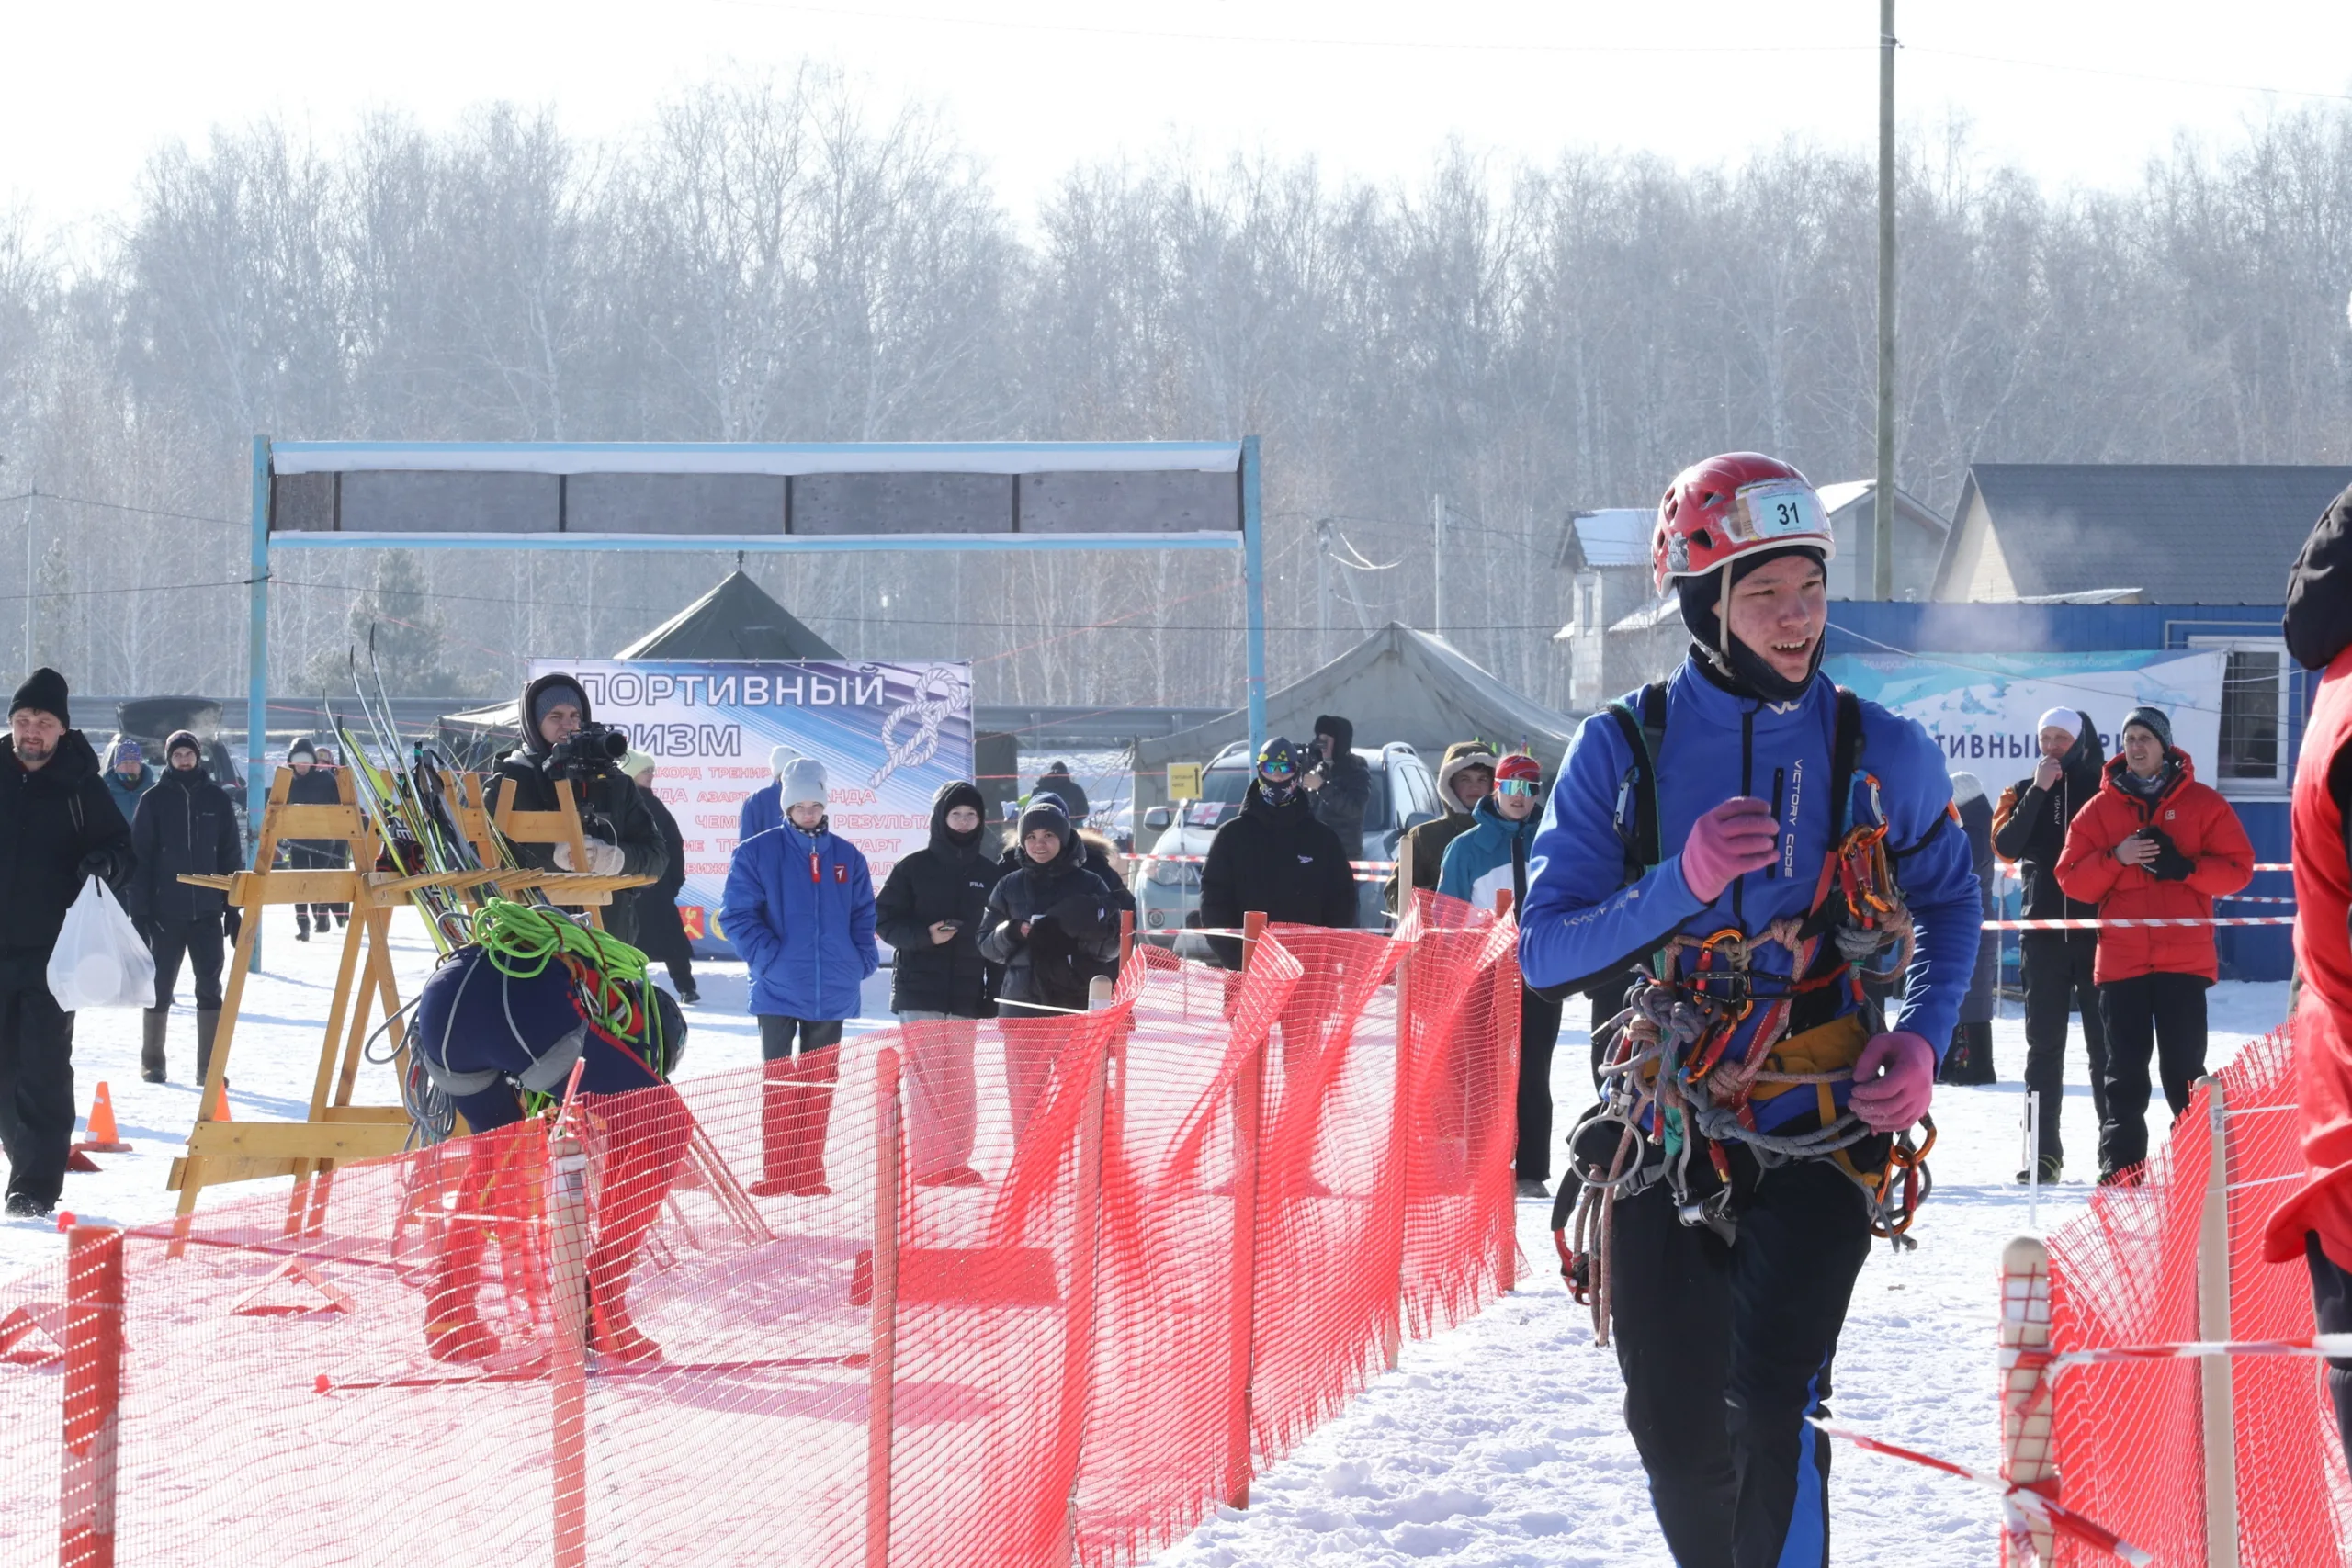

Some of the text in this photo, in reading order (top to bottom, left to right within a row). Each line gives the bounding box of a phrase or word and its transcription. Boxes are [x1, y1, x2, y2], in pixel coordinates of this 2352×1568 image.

[1776, 502, 1800, 525] 31
[1934, 734, 2041, 759] ТИВНЫ
[708, 767, 772, 779] ТРЕНИР
[697, 791, 750, 802] АЗАРТ
[1784, 759, 1803, 878] VICTORY CODE
